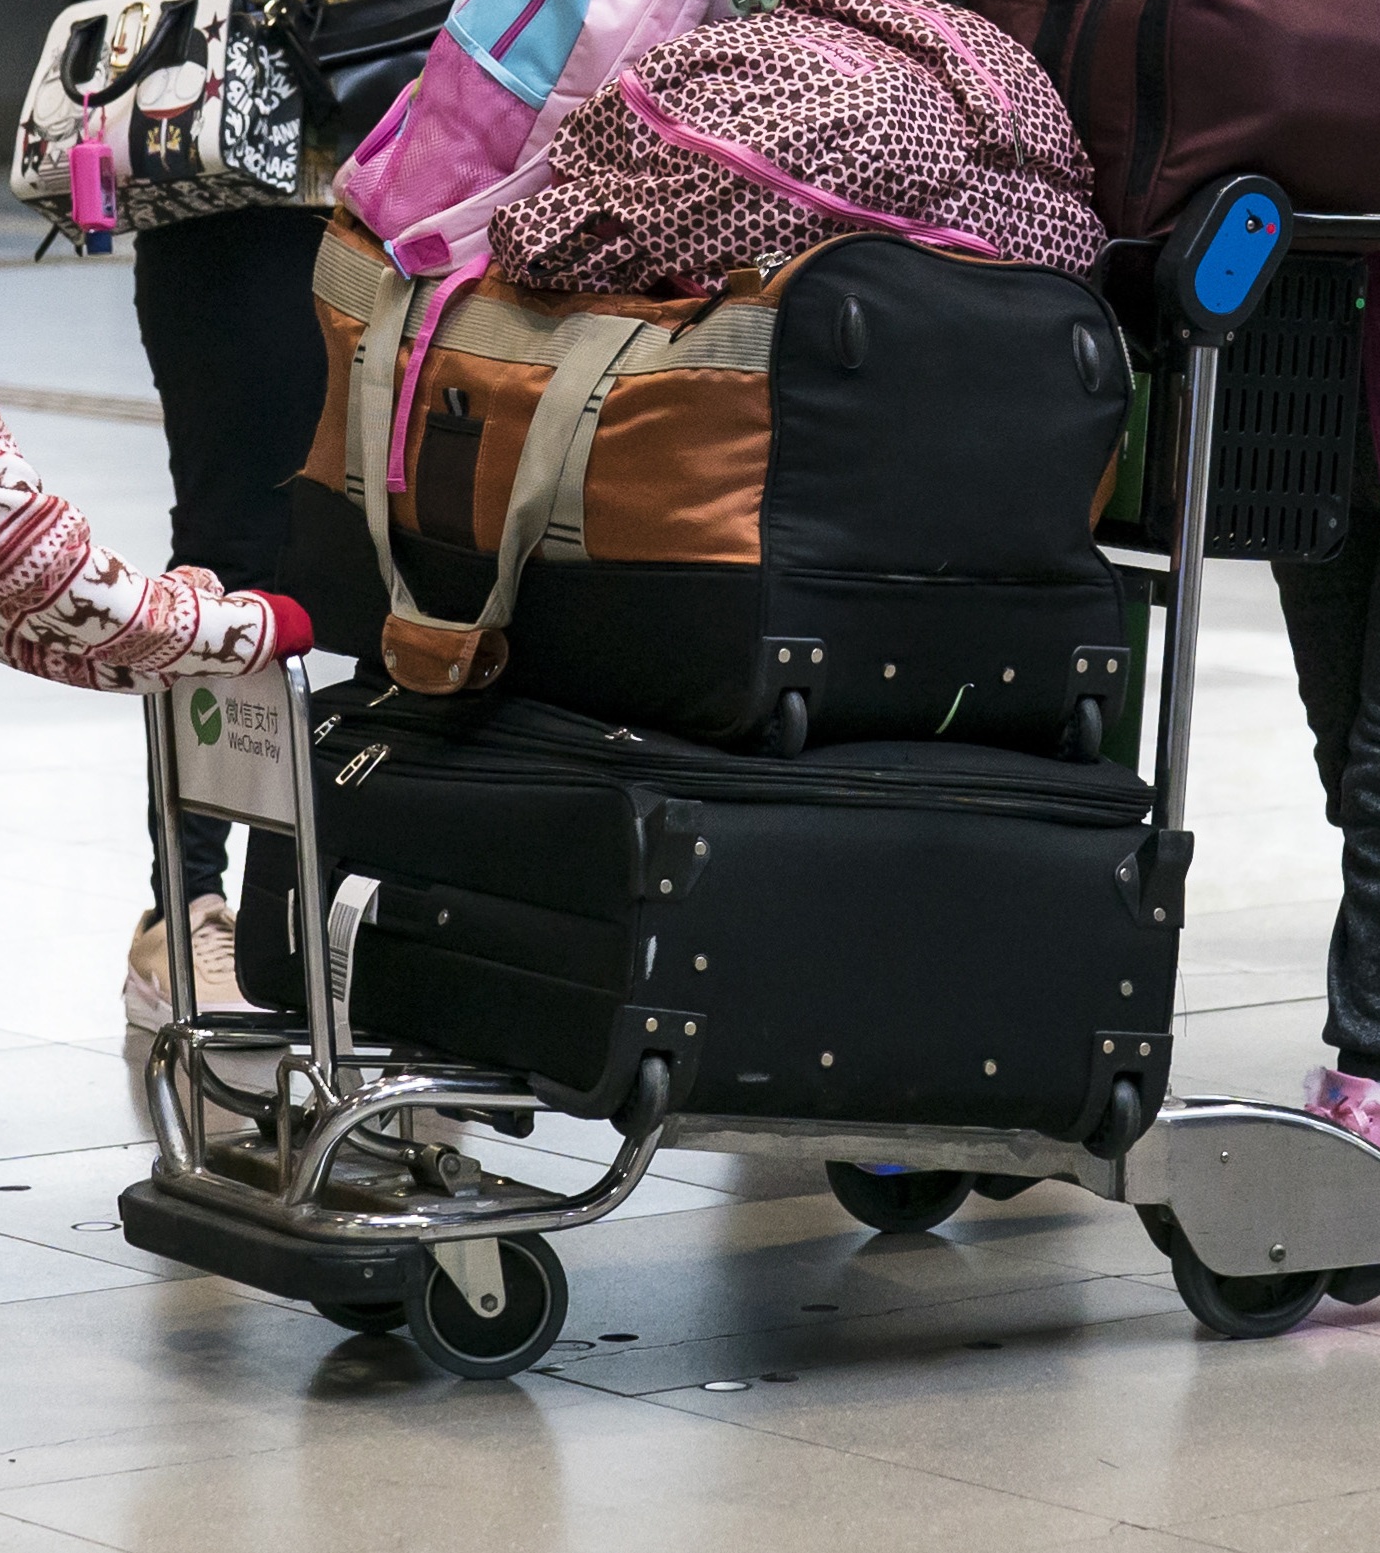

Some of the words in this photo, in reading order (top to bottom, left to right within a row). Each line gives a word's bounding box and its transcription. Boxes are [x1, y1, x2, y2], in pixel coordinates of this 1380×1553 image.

[225, 696, 279, 735] 微信支付
[227, 731, 264, 757] WeChat
[264, 738, 281, 764] Pay
